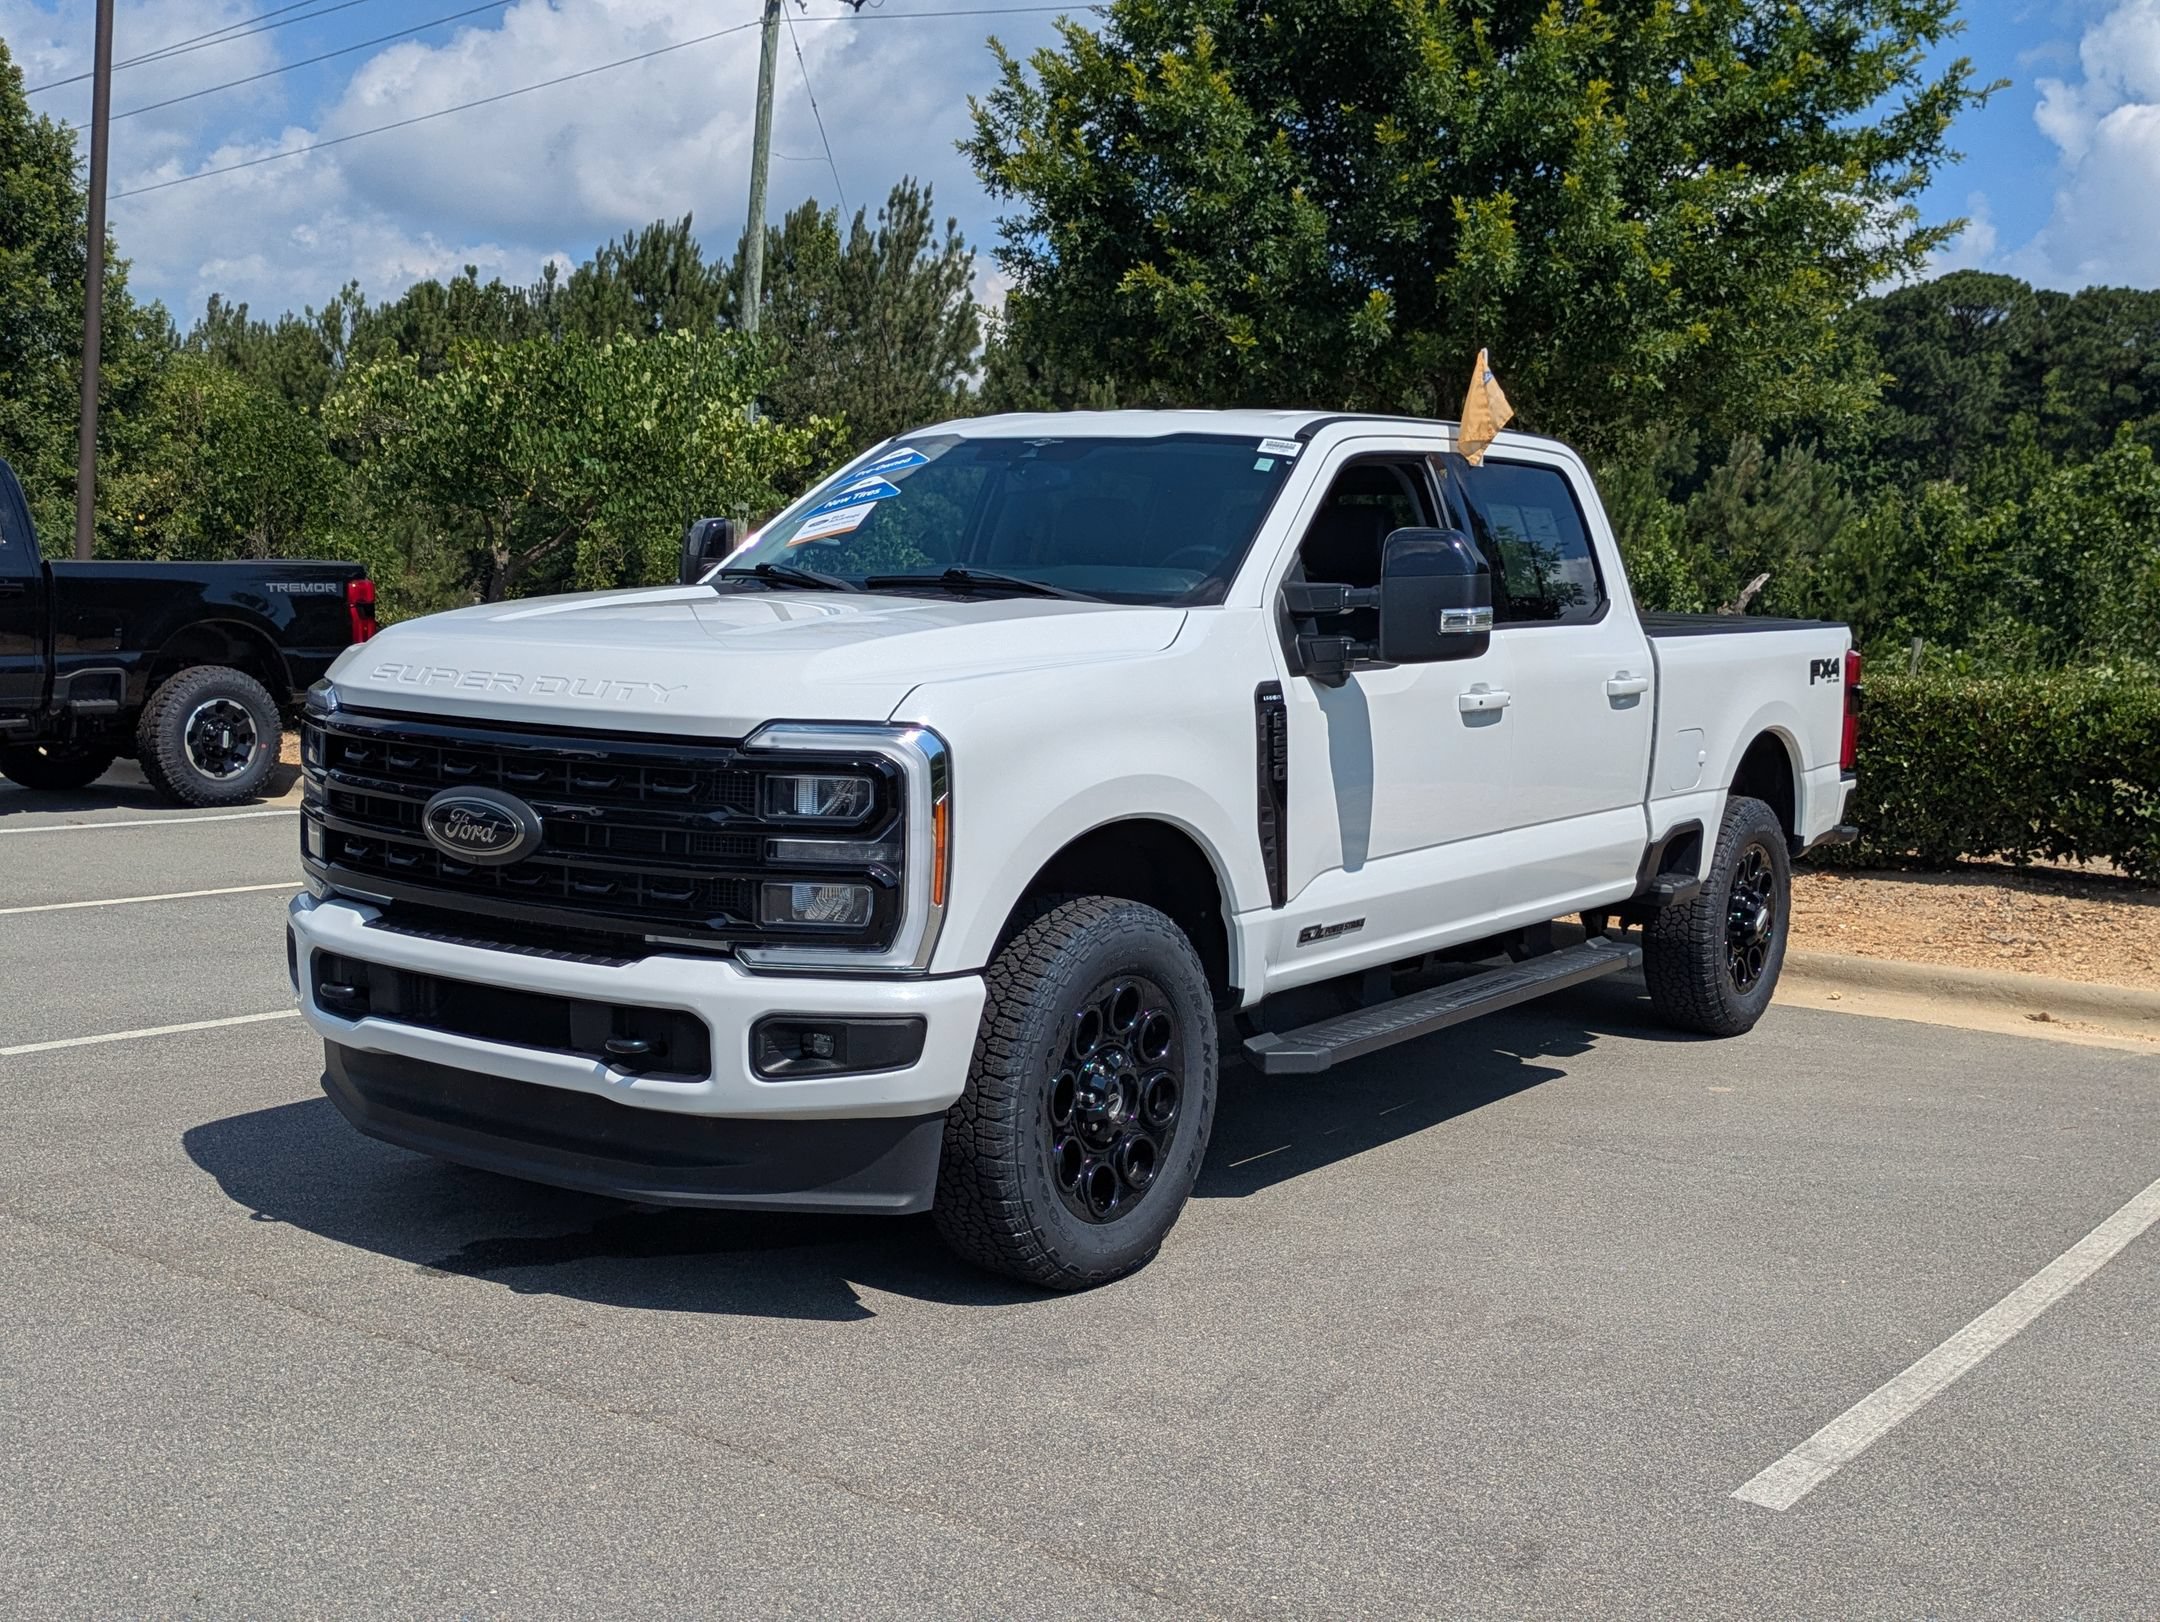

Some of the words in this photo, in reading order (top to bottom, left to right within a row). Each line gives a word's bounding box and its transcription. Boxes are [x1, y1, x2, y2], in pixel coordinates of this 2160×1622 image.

[824, 495, 851, 509] New
[853, 487, 882, 500] Tires
[265, 582, 337, 593] TREMOR
[369, 662, 525, 694] SUPER
[528, 675, 689, 703] DUTY
[1810, 657, 1840, 685] FX4
[445, 807, 499, 844] Ford
